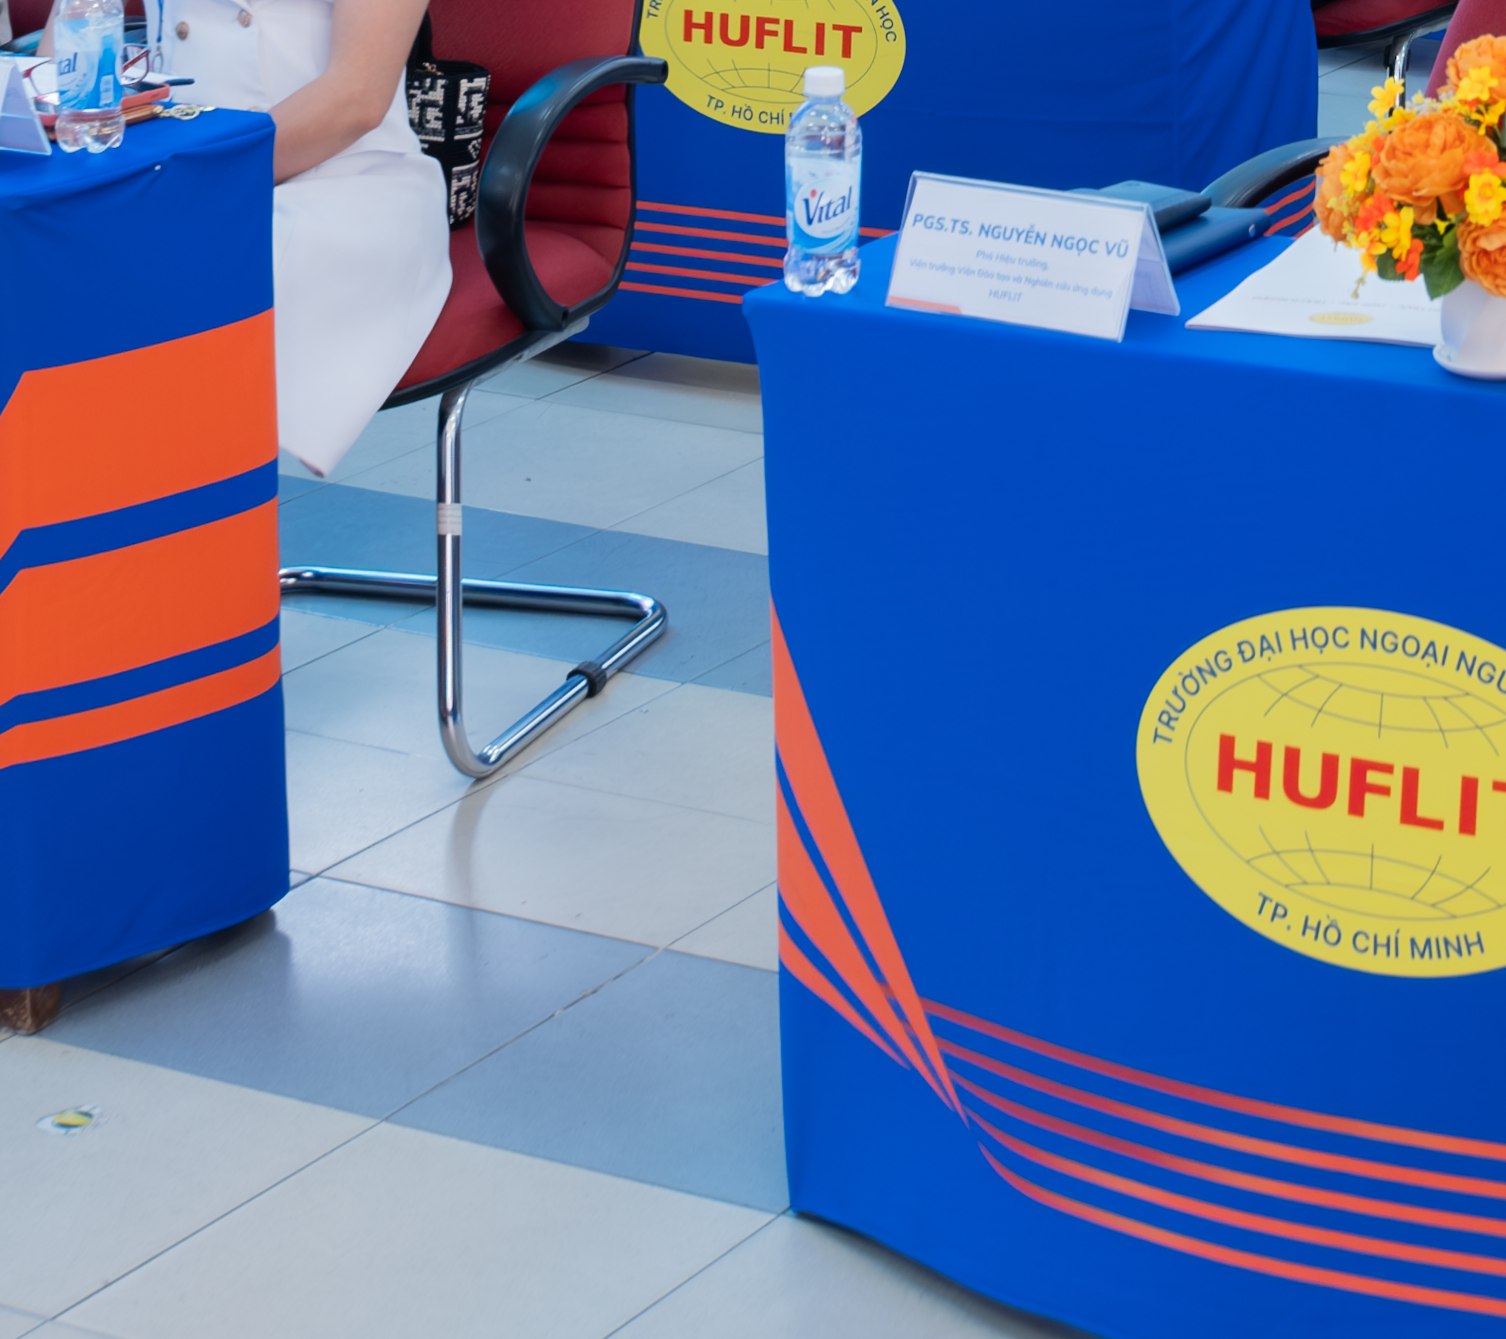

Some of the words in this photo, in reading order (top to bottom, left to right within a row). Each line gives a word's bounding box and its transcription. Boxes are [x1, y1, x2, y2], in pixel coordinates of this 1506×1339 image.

[682, 8, 862, 59] HUFLIT
[803, 185, 853, 226] Vital
[912, 213, 973, 236] PGS.TS.
[978, 223, 1048, 247] NGUYỄN
[1051, 235, 1100, 256] NGỌC
[1105, 239, 1129, 259] VŨ
[1152, 650, 1234, 748] TRƯỜNG
[1236, 630, 1283, 664] ĐẠI
[1289, 626, 1350, 655] HỌC
[1360, 628, 1449, 669] NGOẠI
[1254, 892, 1292, 932] TP.
[1301, 914, 1343, 948] HỒ
[1351, 927, 1401, 960] CHÍ
[1409, 930, 1485, 961] MINH
